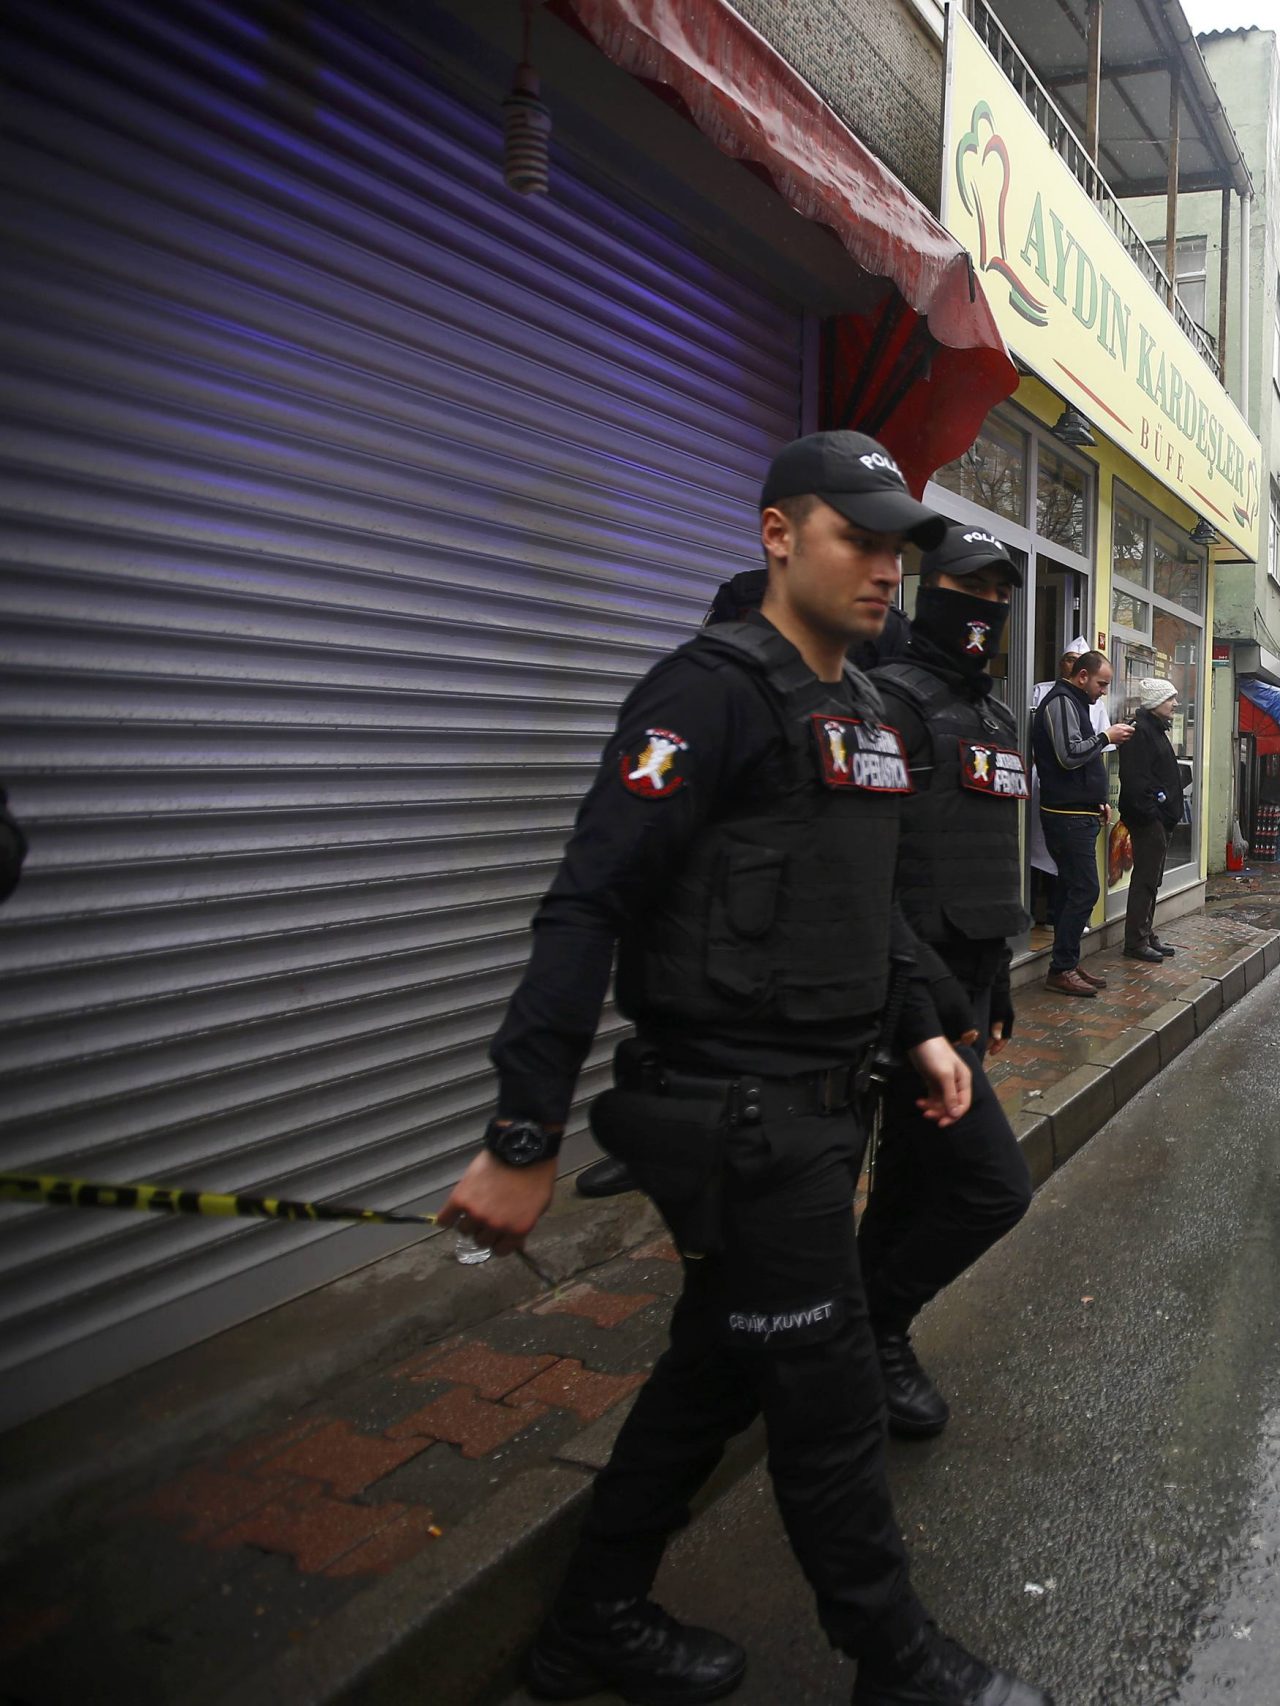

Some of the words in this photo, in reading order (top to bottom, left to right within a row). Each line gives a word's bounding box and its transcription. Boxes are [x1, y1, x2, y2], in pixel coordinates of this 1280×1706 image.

[1020, 192, 1132, 374] AYDIN
[1136, 322, 1245, 499] KARDEŞLER
[1140, 416, 1185, 484] BÜFE
[773, 1303, 832, 1331] KUVVET
